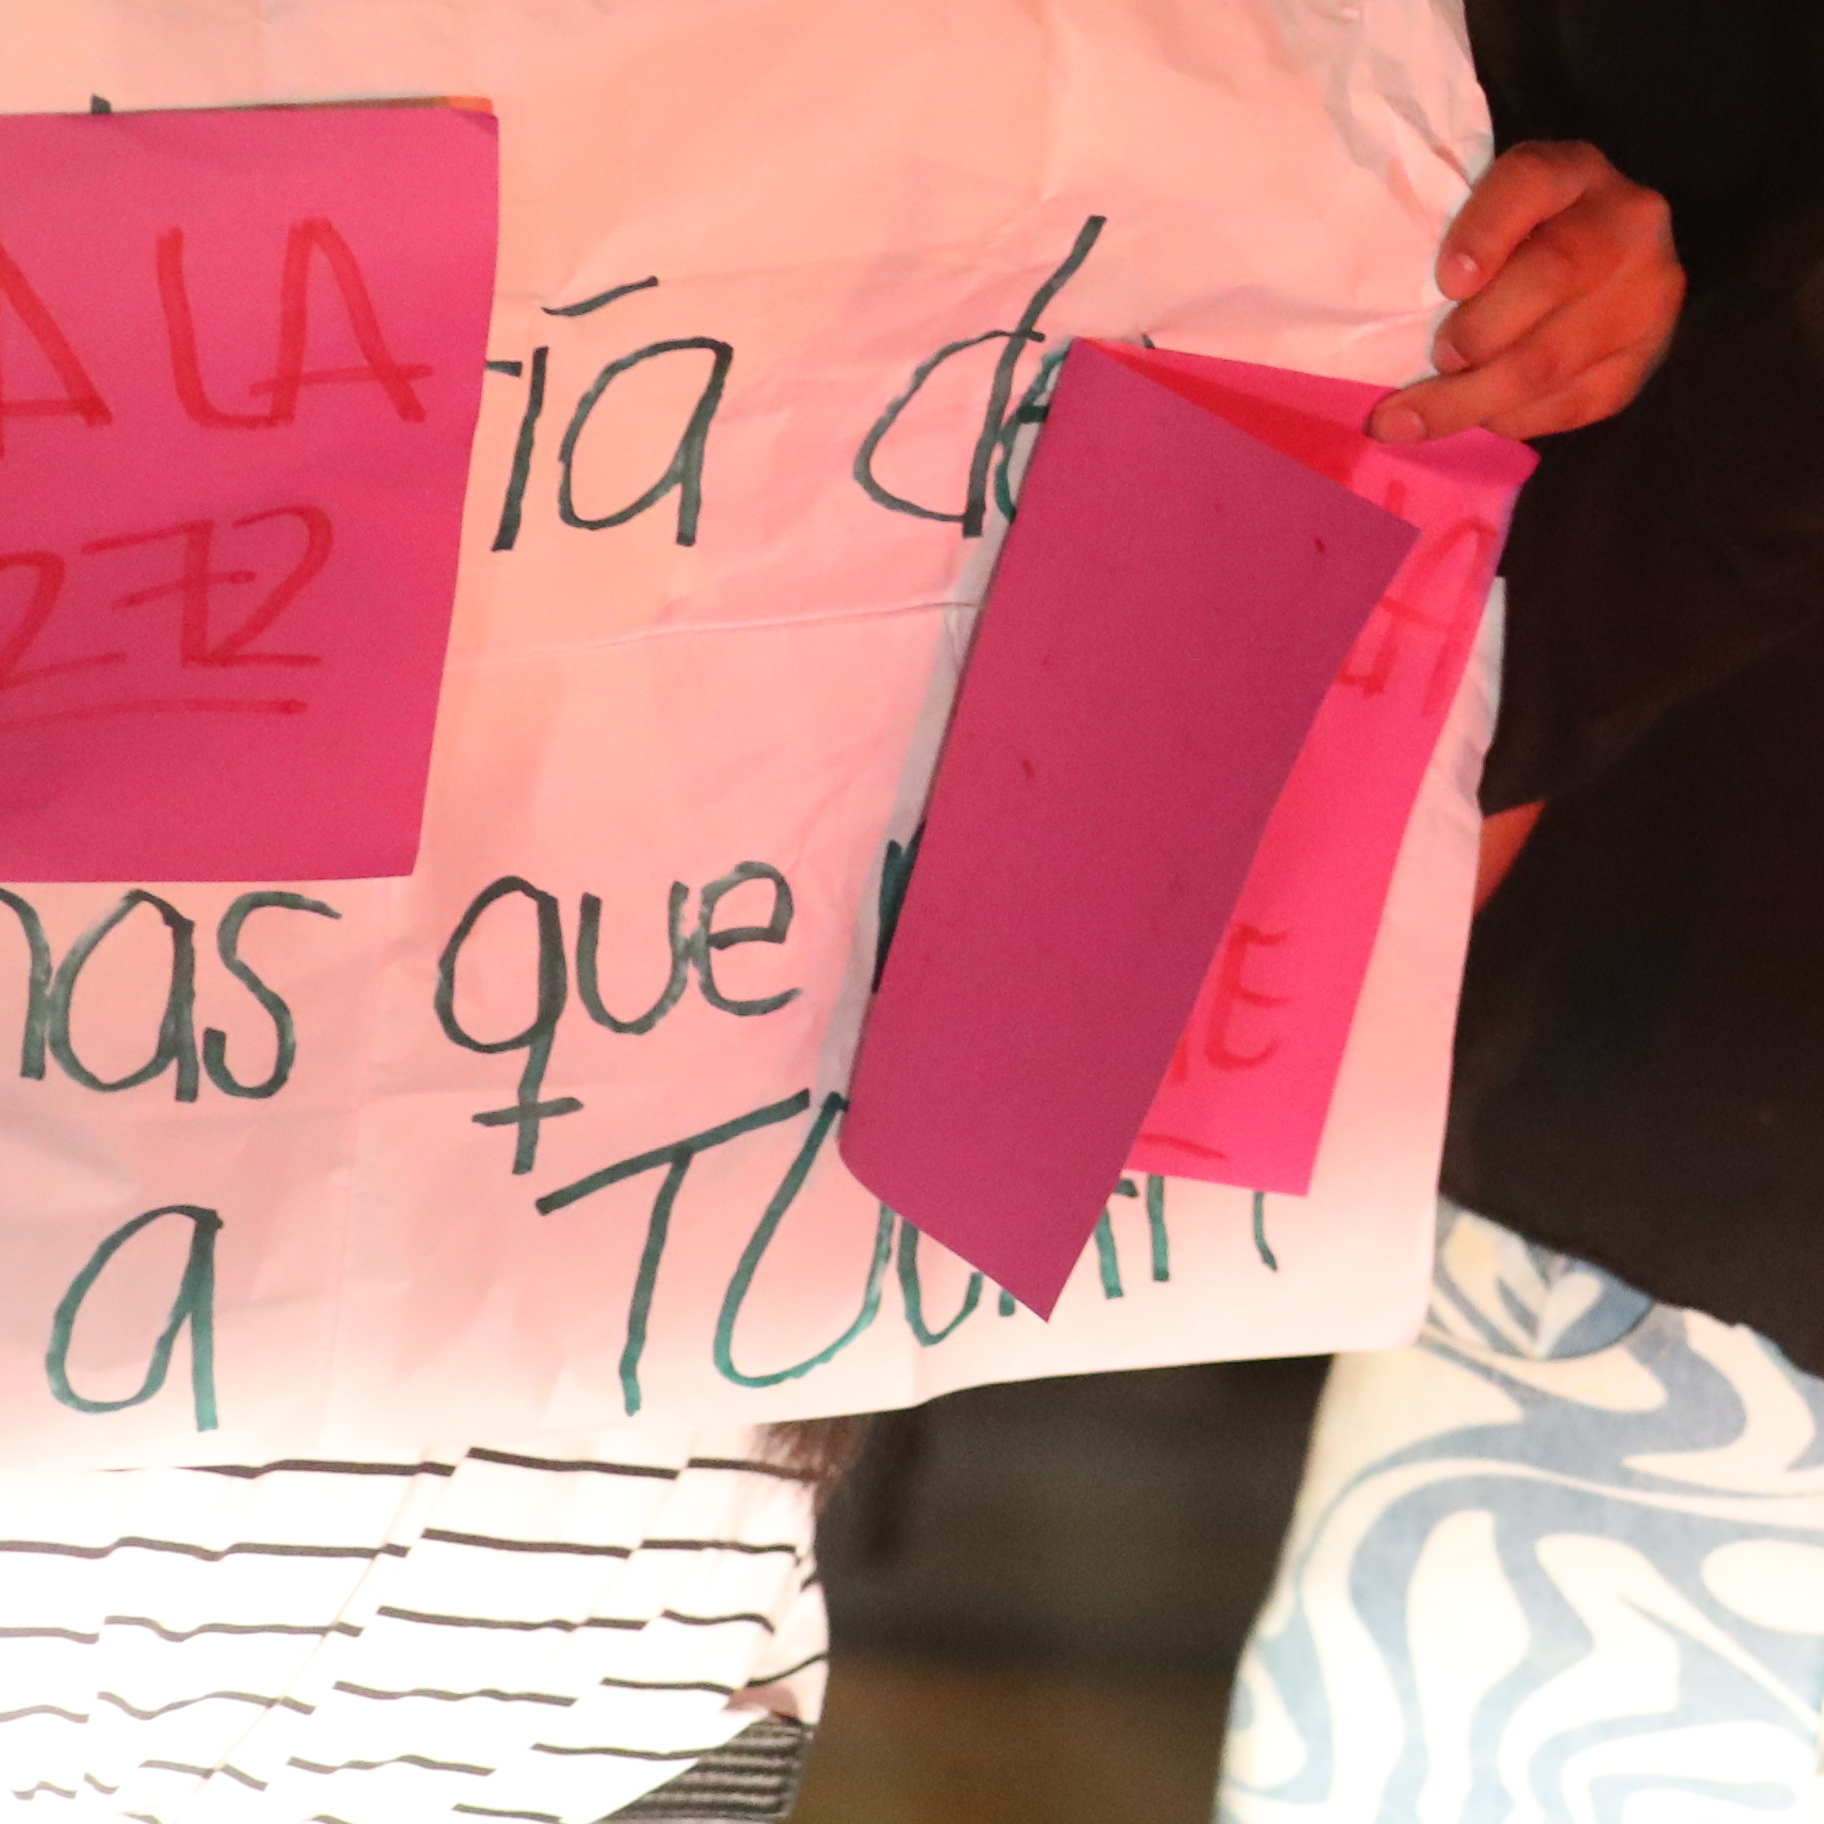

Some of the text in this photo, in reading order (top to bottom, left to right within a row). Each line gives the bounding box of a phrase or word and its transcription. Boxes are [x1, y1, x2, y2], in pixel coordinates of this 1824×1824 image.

[156, 216, 433, 429] LA
[487, 274, 735, 552] ía
[434, 861, 803, 1175] que
